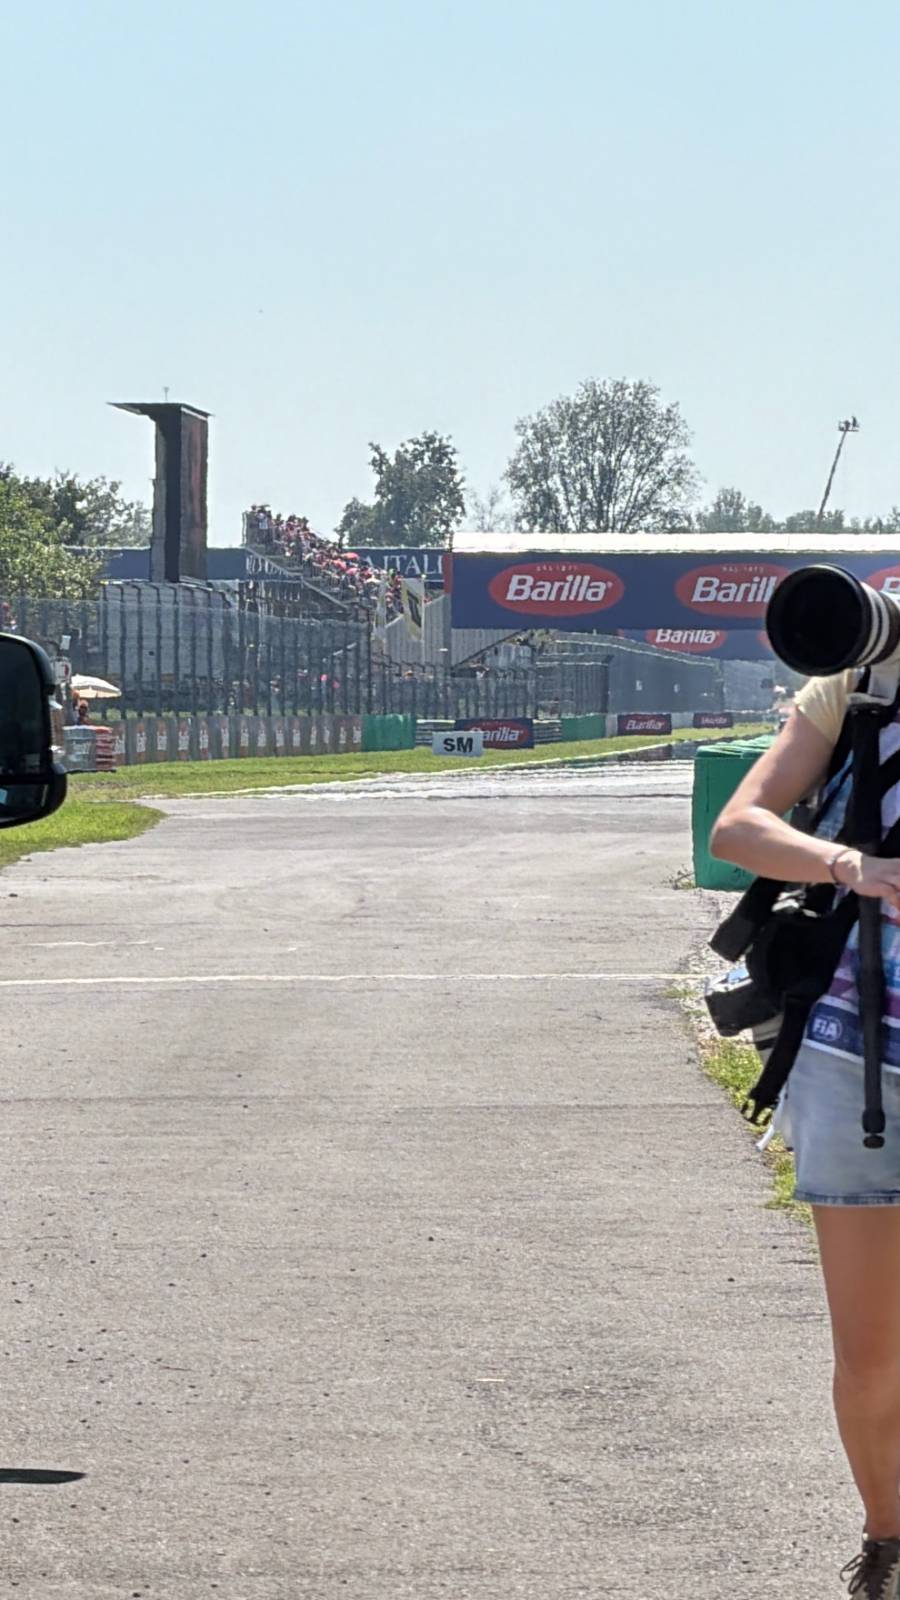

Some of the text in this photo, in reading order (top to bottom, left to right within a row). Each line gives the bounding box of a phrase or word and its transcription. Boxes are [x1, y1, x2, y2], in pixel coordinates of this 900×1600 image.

[506, 574, 608, 602] Barilla
[691, 576, 778, 603] Barill
[655, 628, 717, 644] Barilla
[442, 736, 474, 753] SM
[812, 1018, 838, 1038] FIA
